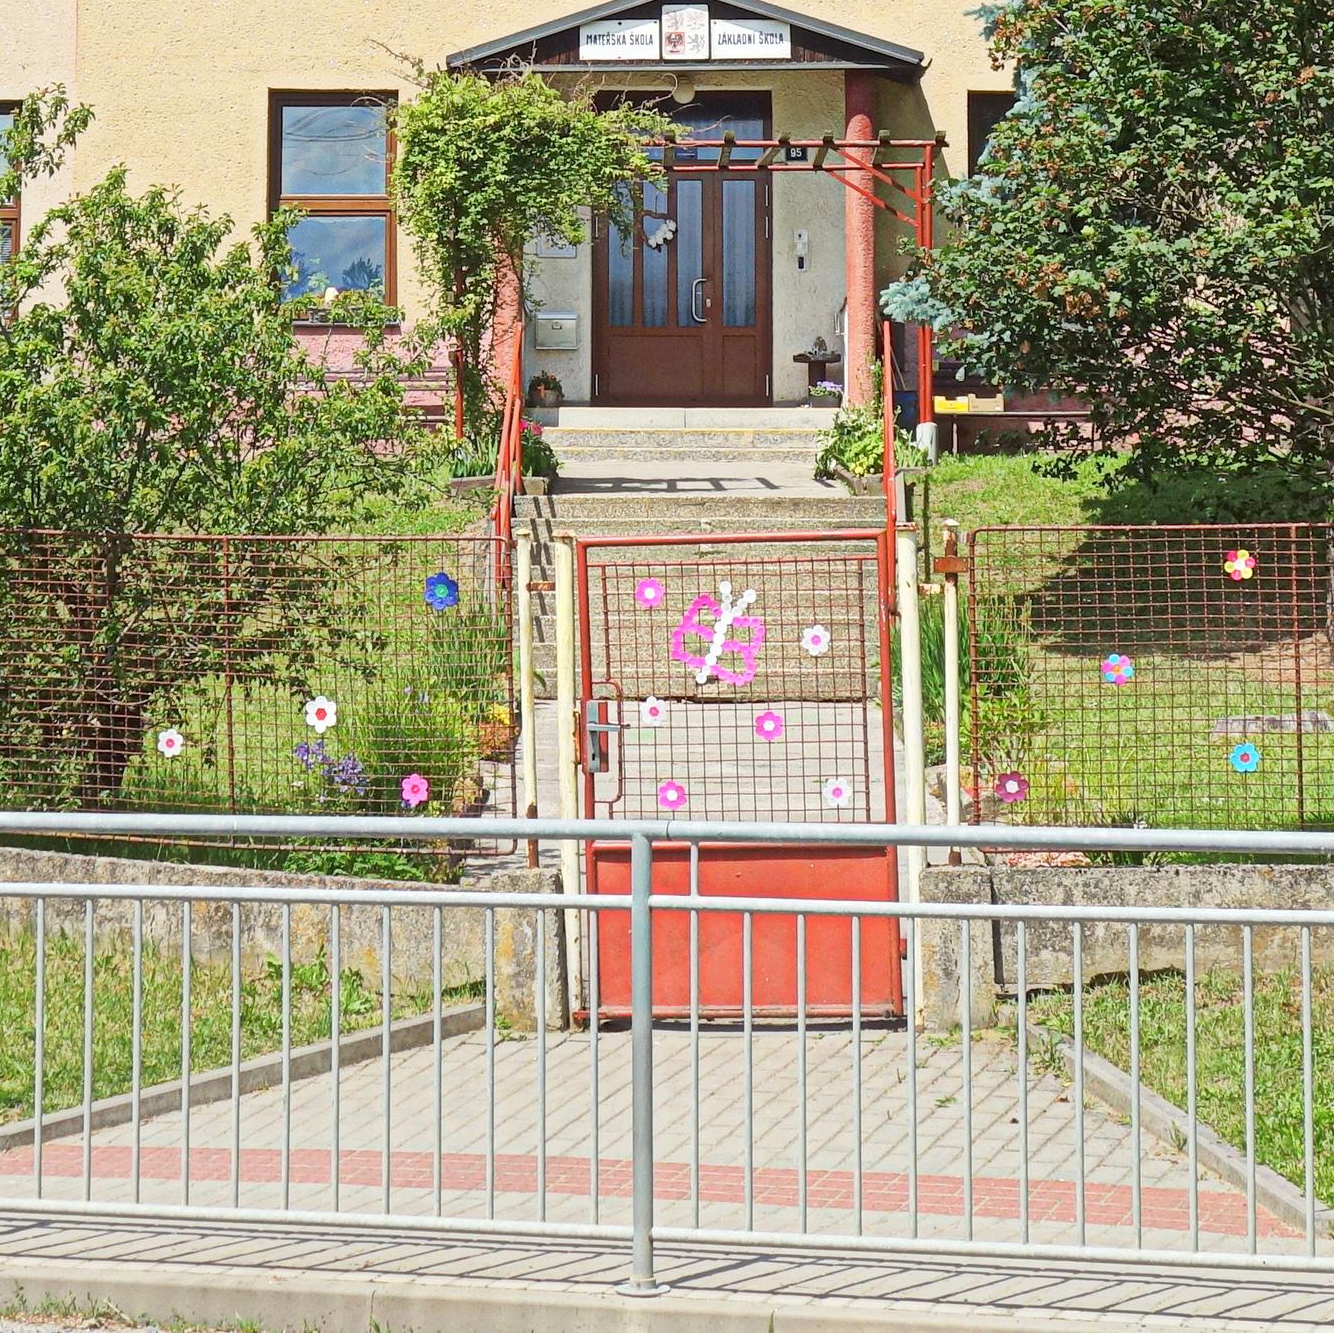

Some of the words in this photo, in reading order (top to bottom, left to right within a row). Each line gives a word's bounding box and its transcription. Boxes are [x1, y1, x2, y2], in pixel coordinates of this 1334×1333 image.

[630, 31, 653, 45] ŠKOLA
[759, 31, 784, 45] ŠKOLA
[790, 147, 802, 158] 95
